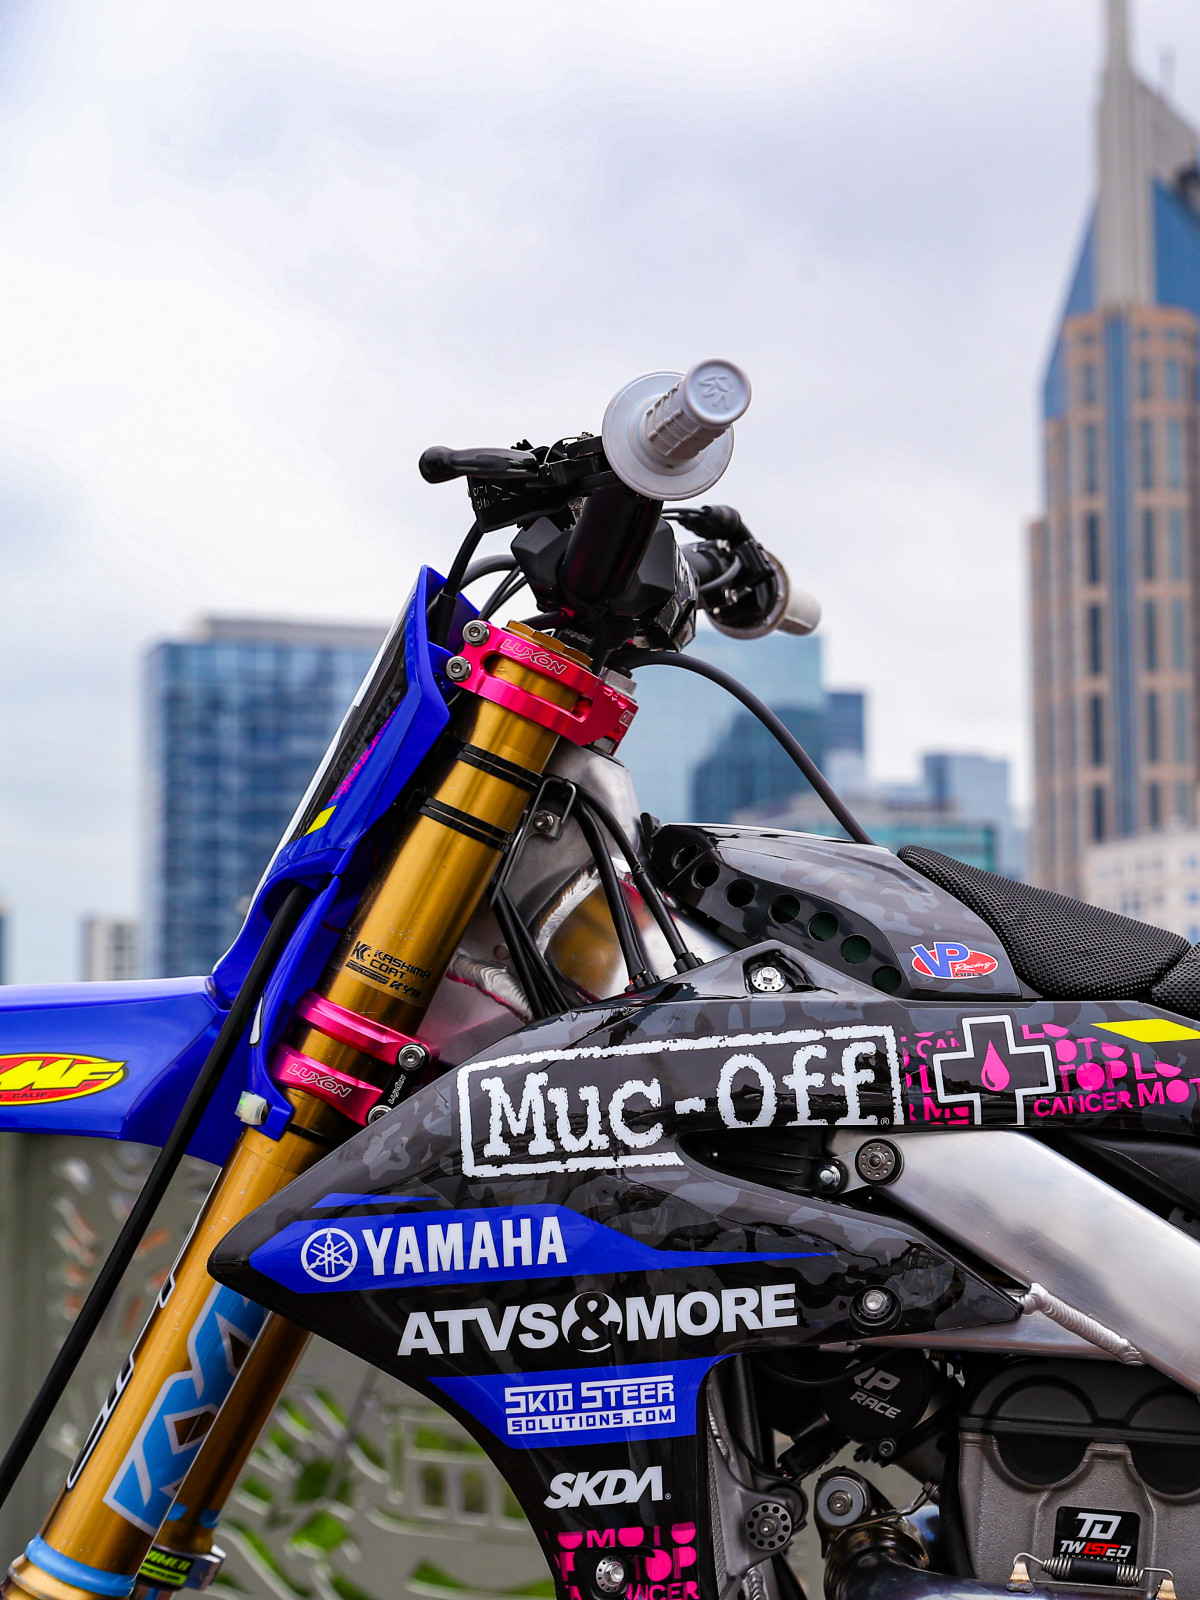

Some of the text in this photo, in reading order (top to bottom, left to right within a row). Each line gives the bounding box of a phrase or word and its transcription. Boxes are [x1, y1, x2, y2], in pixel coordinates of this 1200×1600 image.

[500, 638, 567, 675] LUXON
[369, 958, 409, 980] COAT
[374, 949, 432, 979] KASHIMA
[911, 942, 970, 978] VP
[954, 960, 996, 973] Racing
[0, 1058, 127, 1091] MF
[287, 1063, 352, 1098] LUXON
[479, 1040, 879, 1158] Muc-Off
[1033, 1089, 1133, 1117] CANCER
[362, 1216, 568, 1276] YAMAHA
[397, 1284, 798, 1356] ATVS&MORE
[504, 1374, 675, 1415] SKID STEER
[850, 1391, 902, 1419] RACE
[511, 1407, 673, 1433] SOLUTIONS.COM
[543, 1465, 664, 1510] SKDA
[1075, 1512, 1122, 1540] TD
[1060, 1539, 1132, 1558] TWISTED
